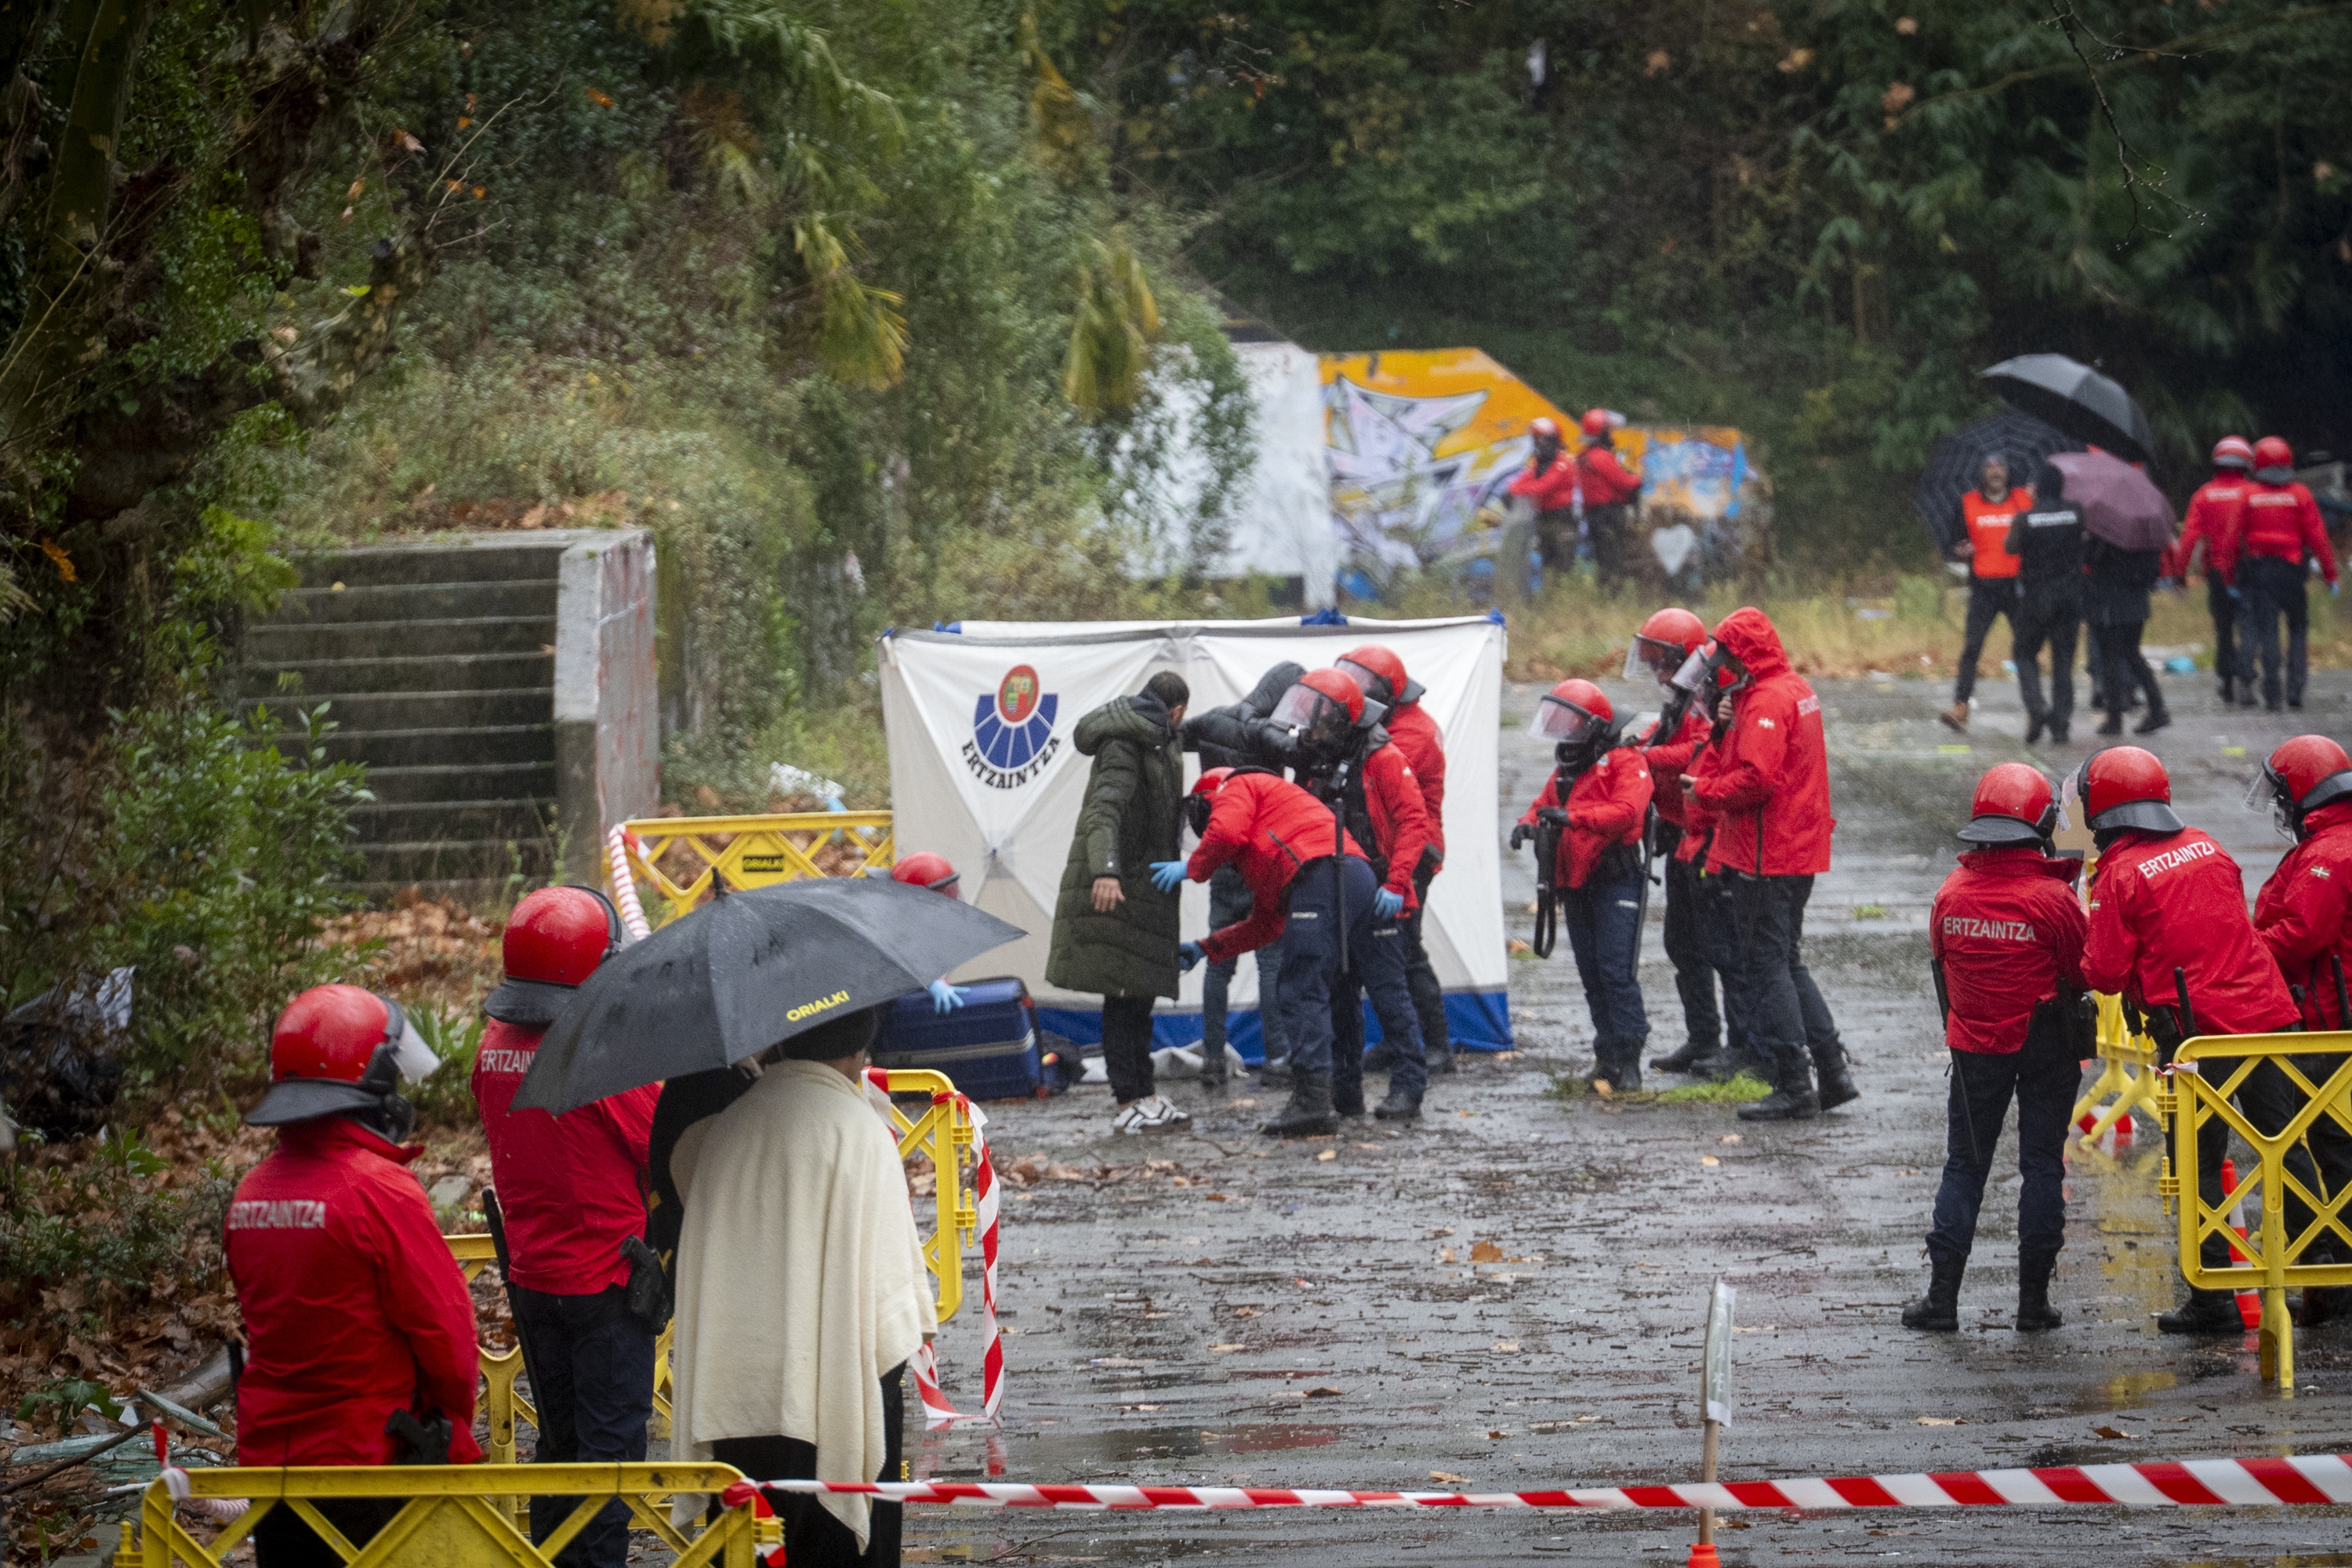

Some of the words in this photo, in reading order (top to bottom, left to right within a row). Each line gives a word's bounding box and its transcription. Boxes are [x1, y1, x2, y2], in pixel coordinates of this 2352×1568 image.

[962, 737, 1060, 789] ERTZAINTZA
[1944, 916, 2036, 941] ERTZAINTZA
[786, 989, 850, 1022] ORIALKI
[229, 1200, 326, 1229] ERTZAINTZA
